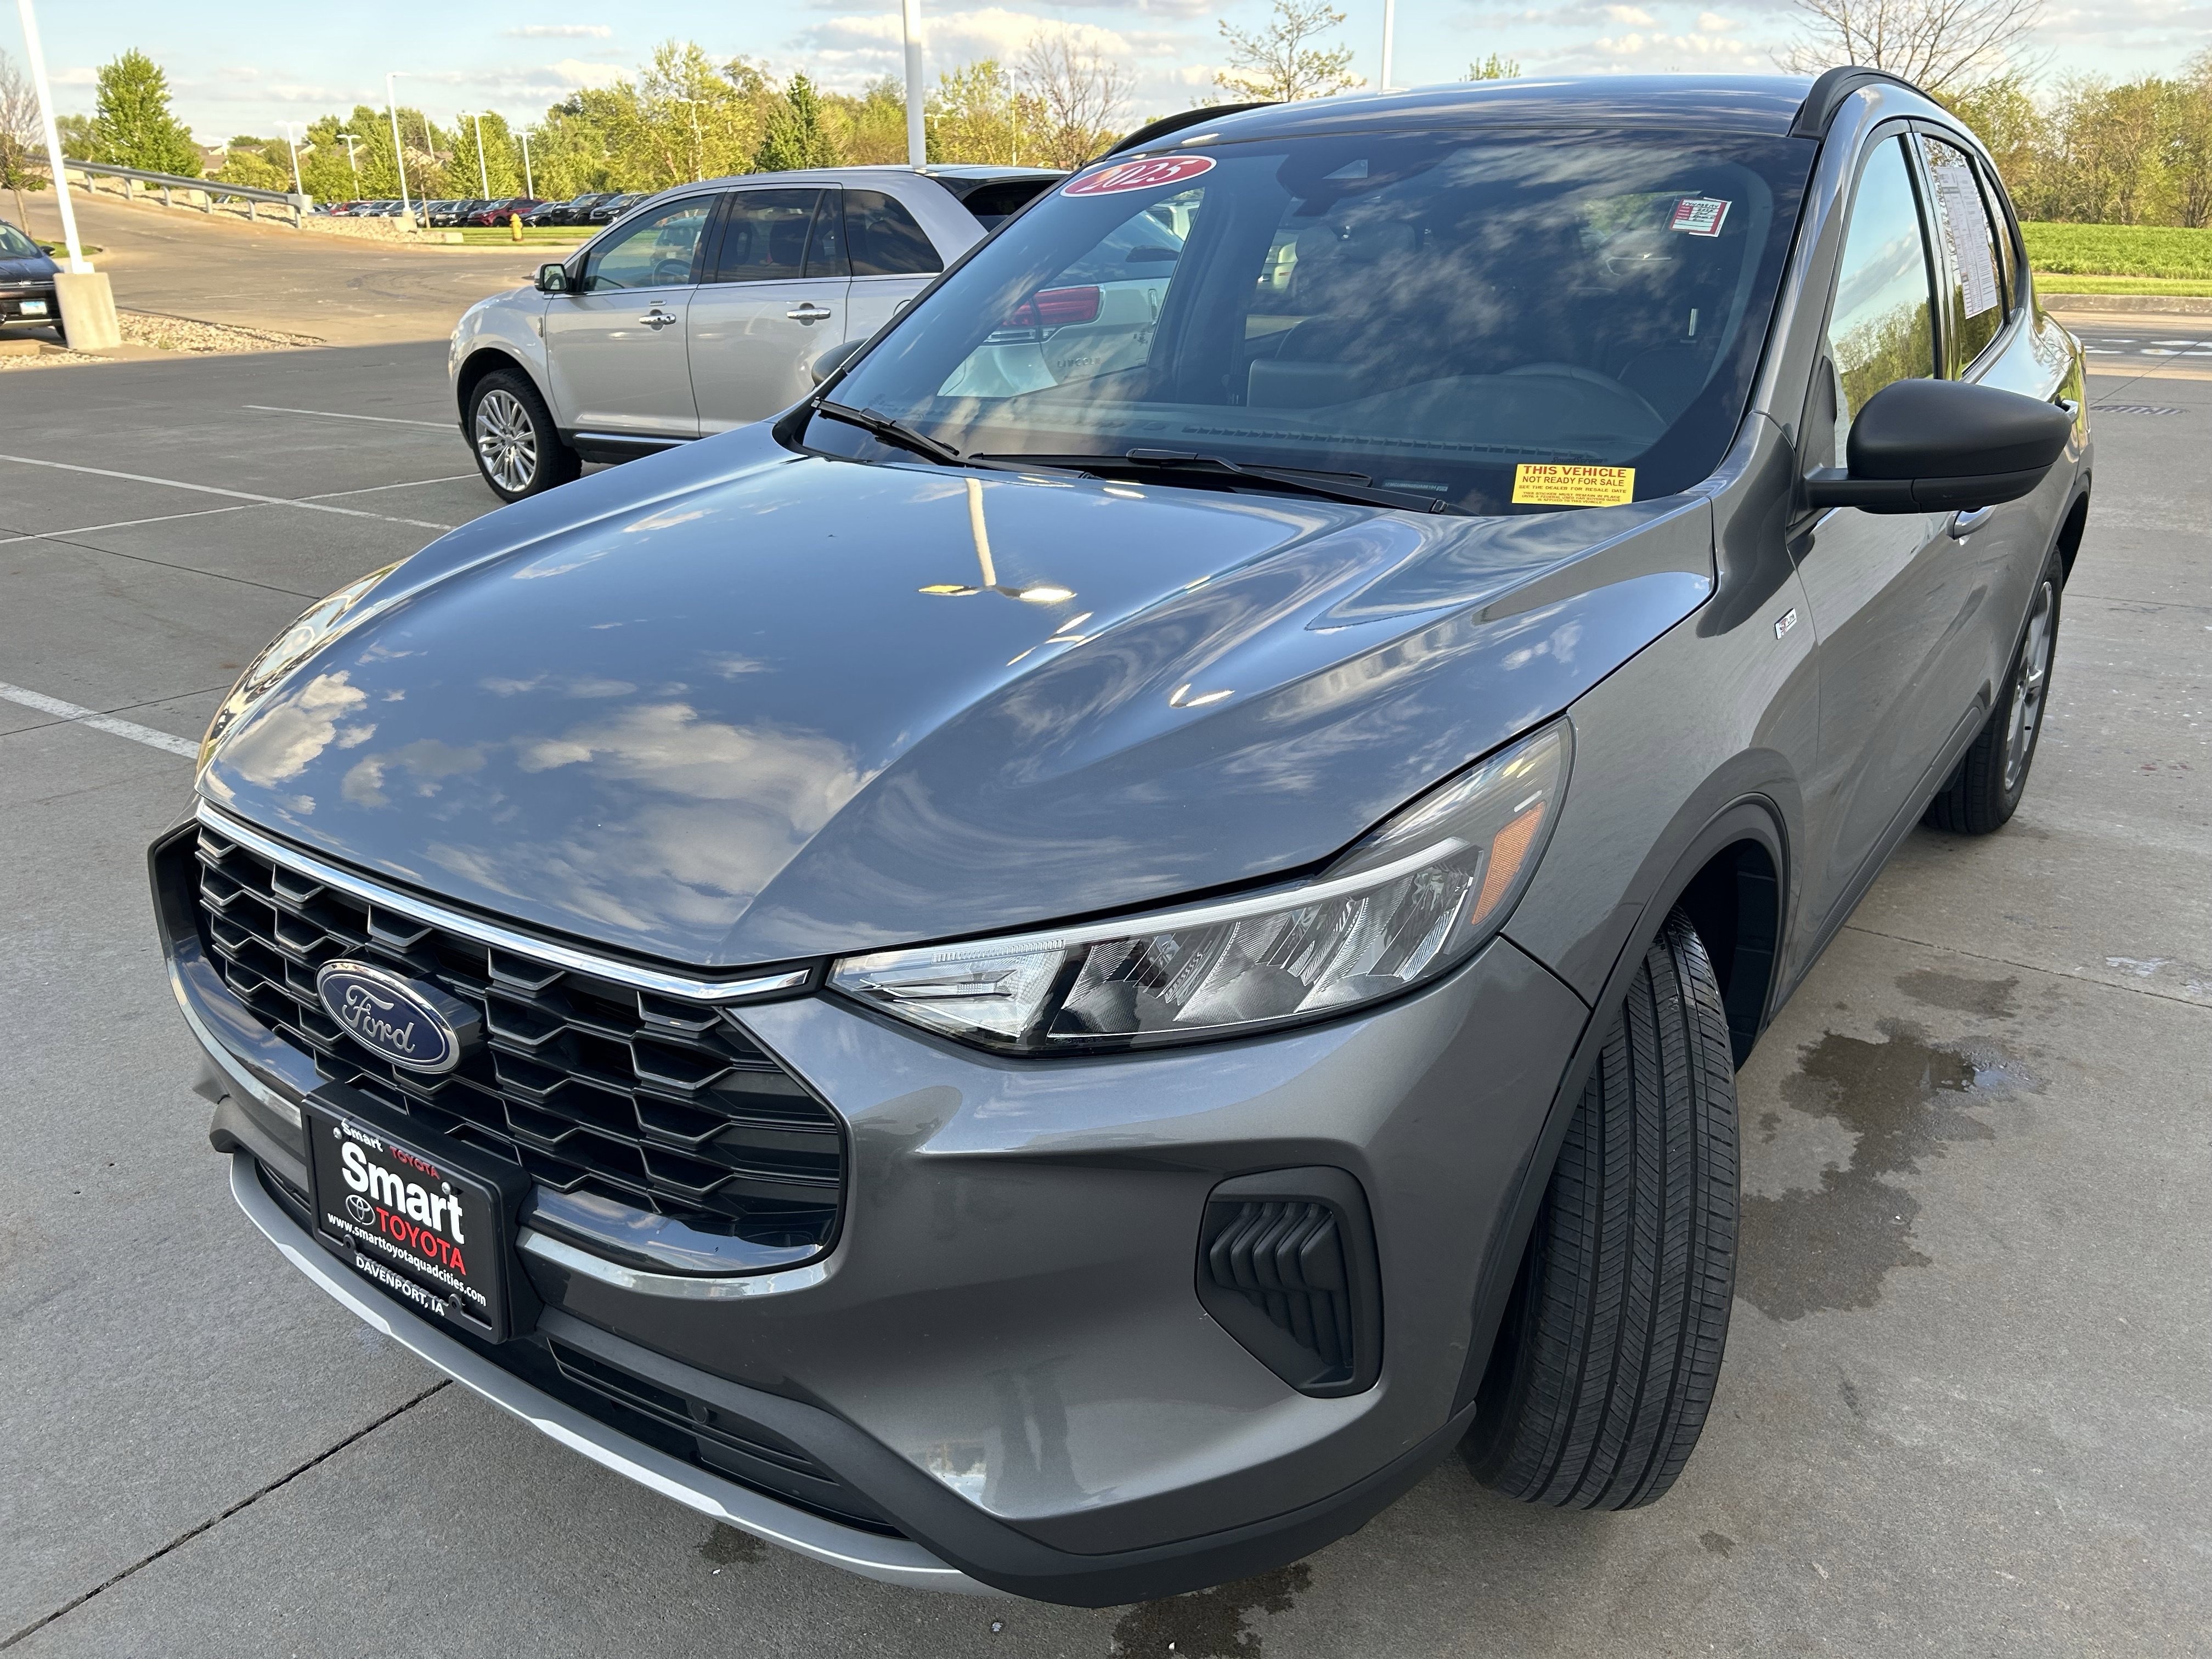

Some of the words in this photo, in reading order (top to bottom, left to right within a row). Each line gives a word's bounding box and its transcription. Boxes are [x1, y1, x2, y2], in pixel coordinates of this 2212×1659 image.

[1074, 159, 1200, 193] 2025
[1523, 465, 1558, 475] THIS
[1562, 466, 1627, 478] VEHICLE
[1544, 476, 1576, 484] READY
[1578, 477, 1598, 486] FOR
[1600, 478, 1624, 487] SALE
[342, 985, 415, 1053] Ford
[341, 1119, 383, 1153] Smart
[389, 1146, 441, 1180] TOYOTA
[341, 1142, 465, 1244] Smart
[328, 1212, 487, 1307] www.smarttoyotaquadcities.com
[376, 1207, 466, 1276] TOYOTA
[356, 1256, 428, 1308] DAVENPORT,
[432, 1294, 445, 1316] IA
